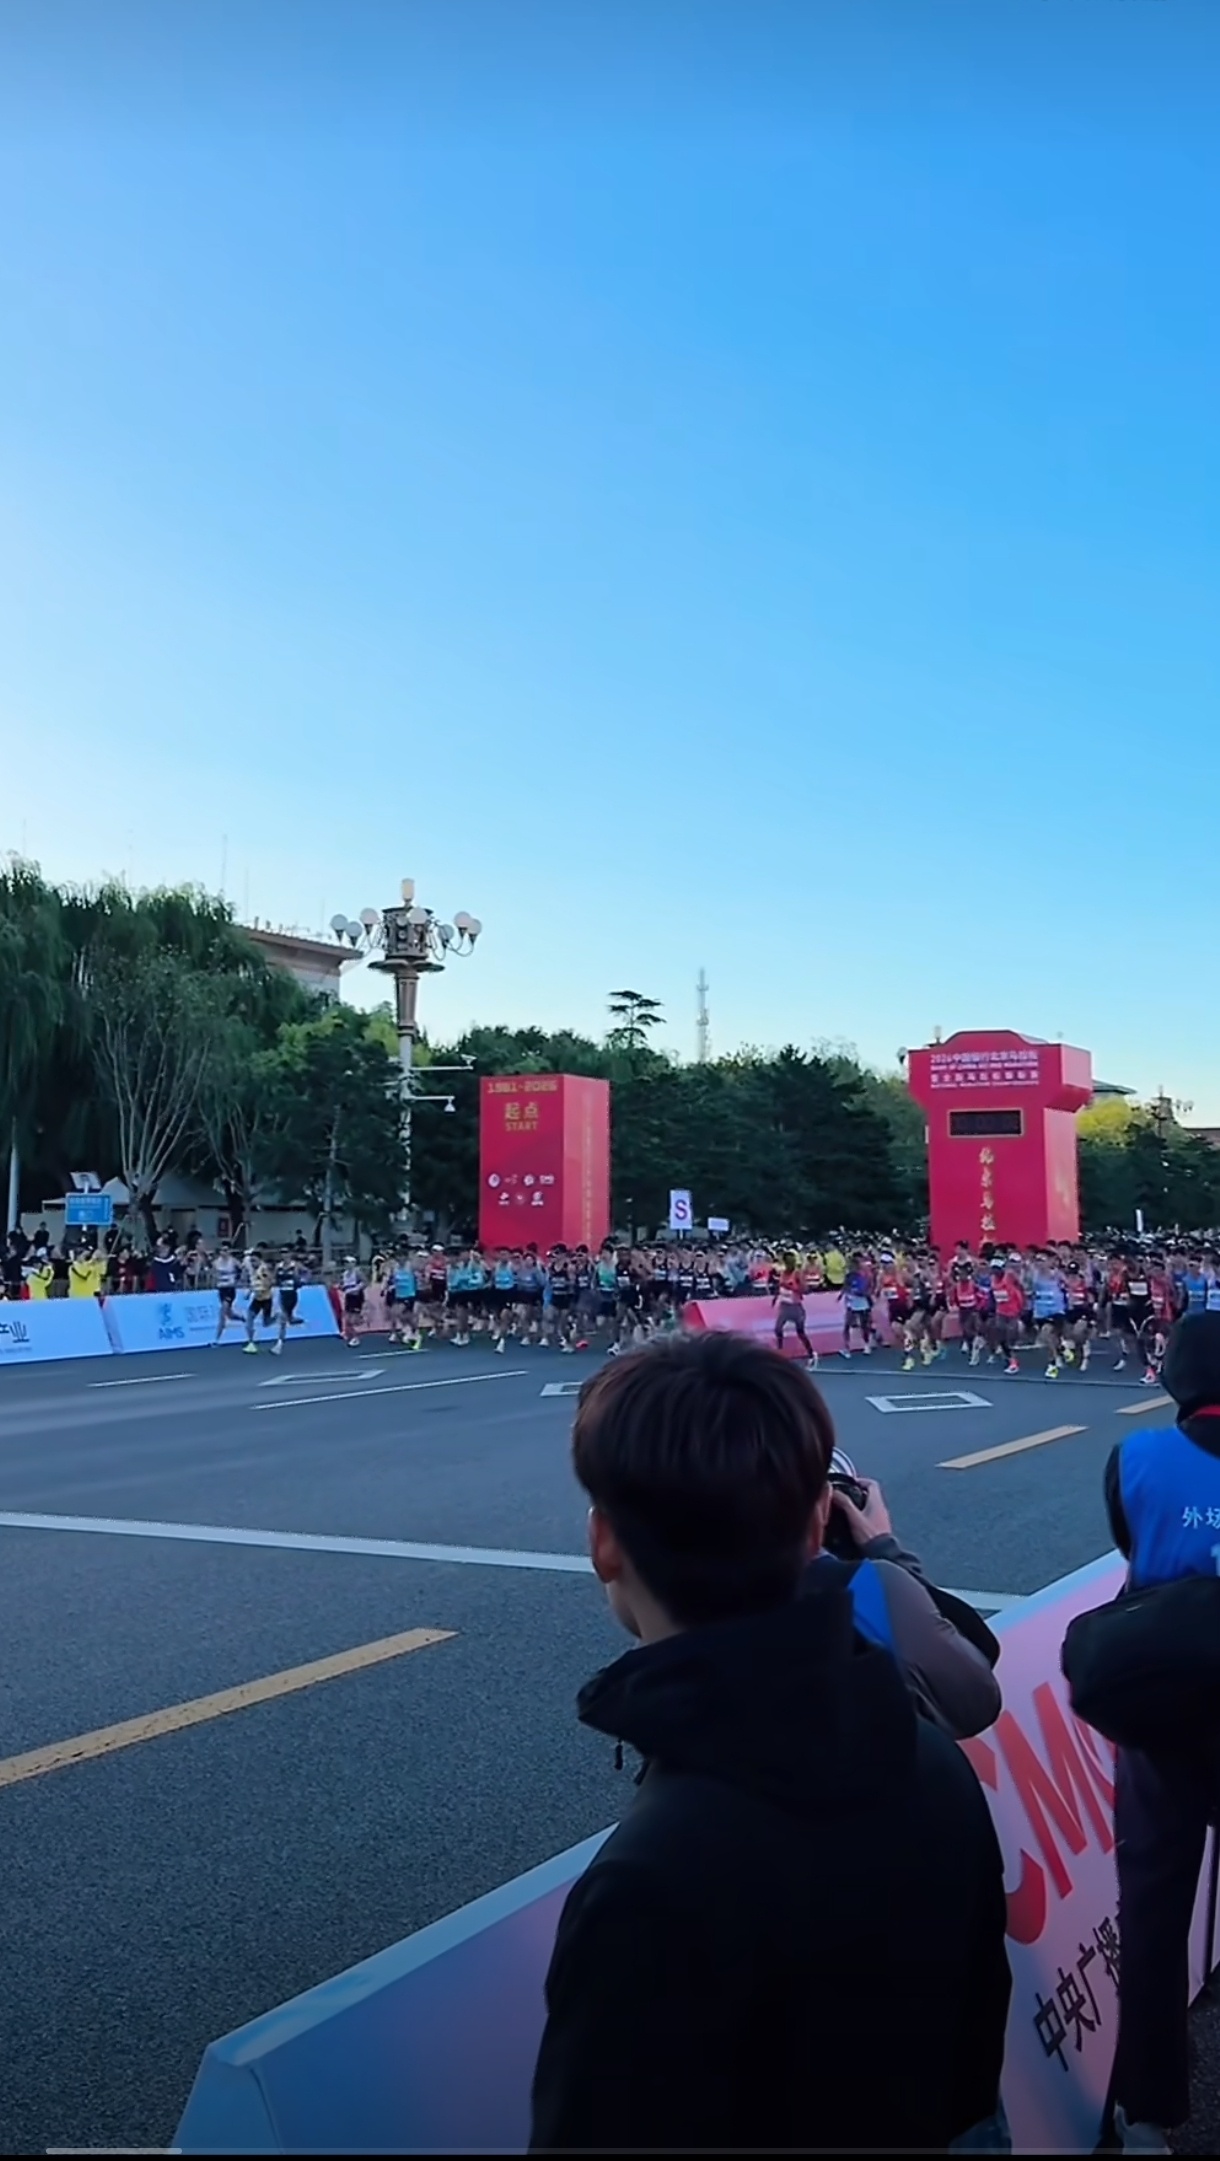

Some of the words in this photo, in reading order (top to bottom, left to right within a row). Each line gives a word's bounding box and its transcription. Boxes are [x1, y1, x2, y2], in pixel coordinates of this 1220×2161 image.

[505, 1102, 539, 1120] 起点
[505, 1121, 539, 1132] START
[675, 1199, 688, 1220] S
